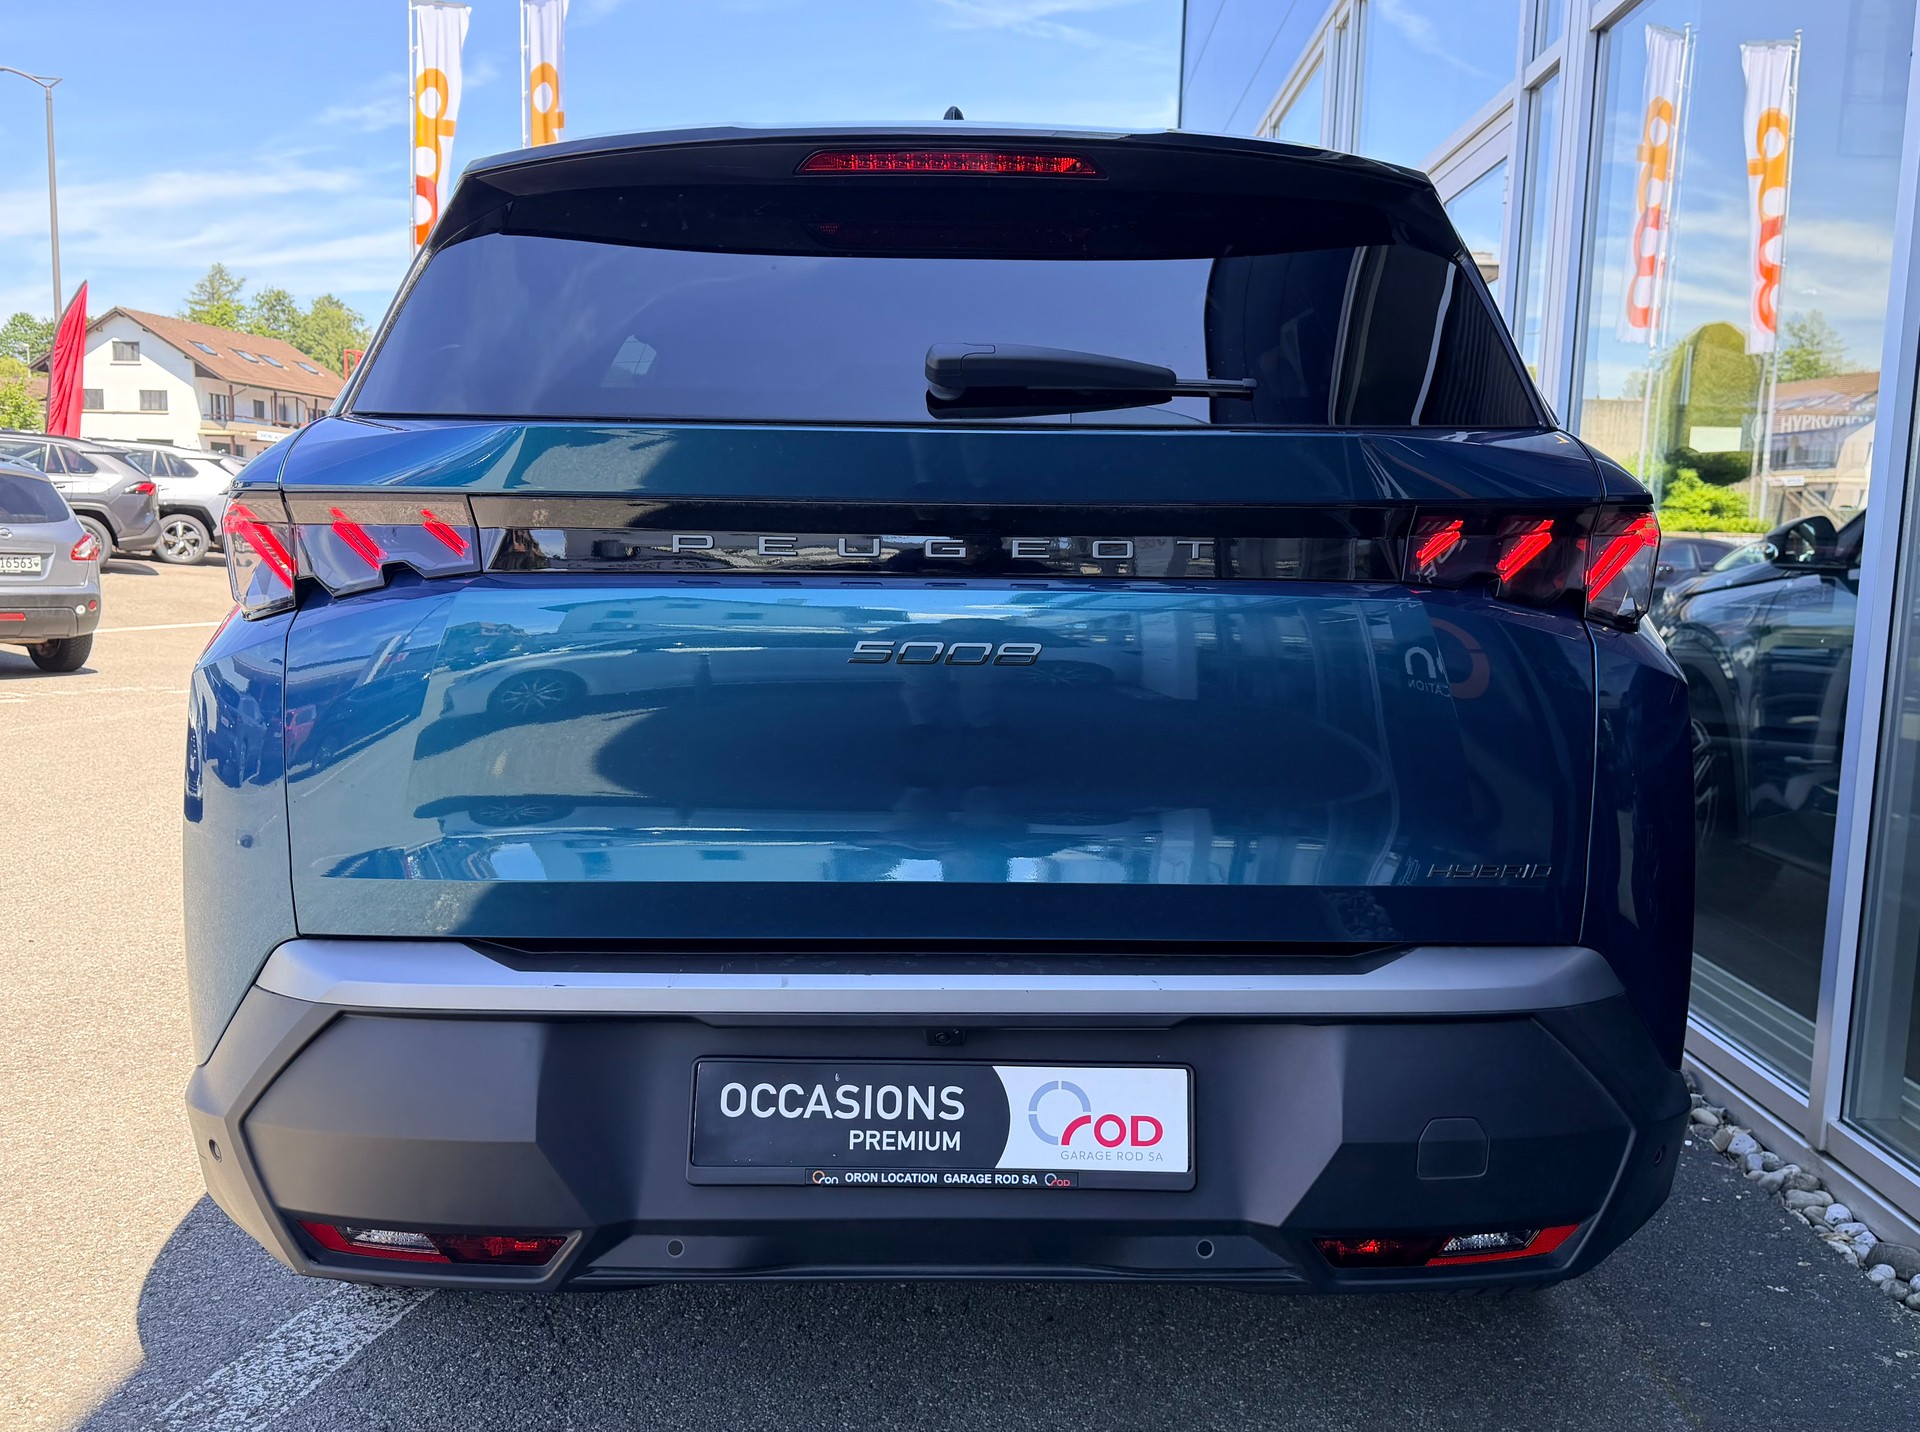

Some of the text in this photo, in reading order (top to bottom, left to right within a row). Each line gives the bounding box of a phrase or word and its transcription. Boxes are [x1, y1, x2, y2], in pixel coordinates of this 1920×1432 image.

[671, 534, 1214, 560] PEUGEOT
[847, 641, 1043, 666] 5008
[1427, 864, 1552, 878] HYBRID
[720, 1082, 965, 1121] OCCASIONS
[849, 1130, 961, 1151] PREMIUM
[1060, 1151, 1164, 1162] GARAGE ROD SA
[845, 1172, 1038, 1185] ORON LOCATION GARAGE ROD SA
